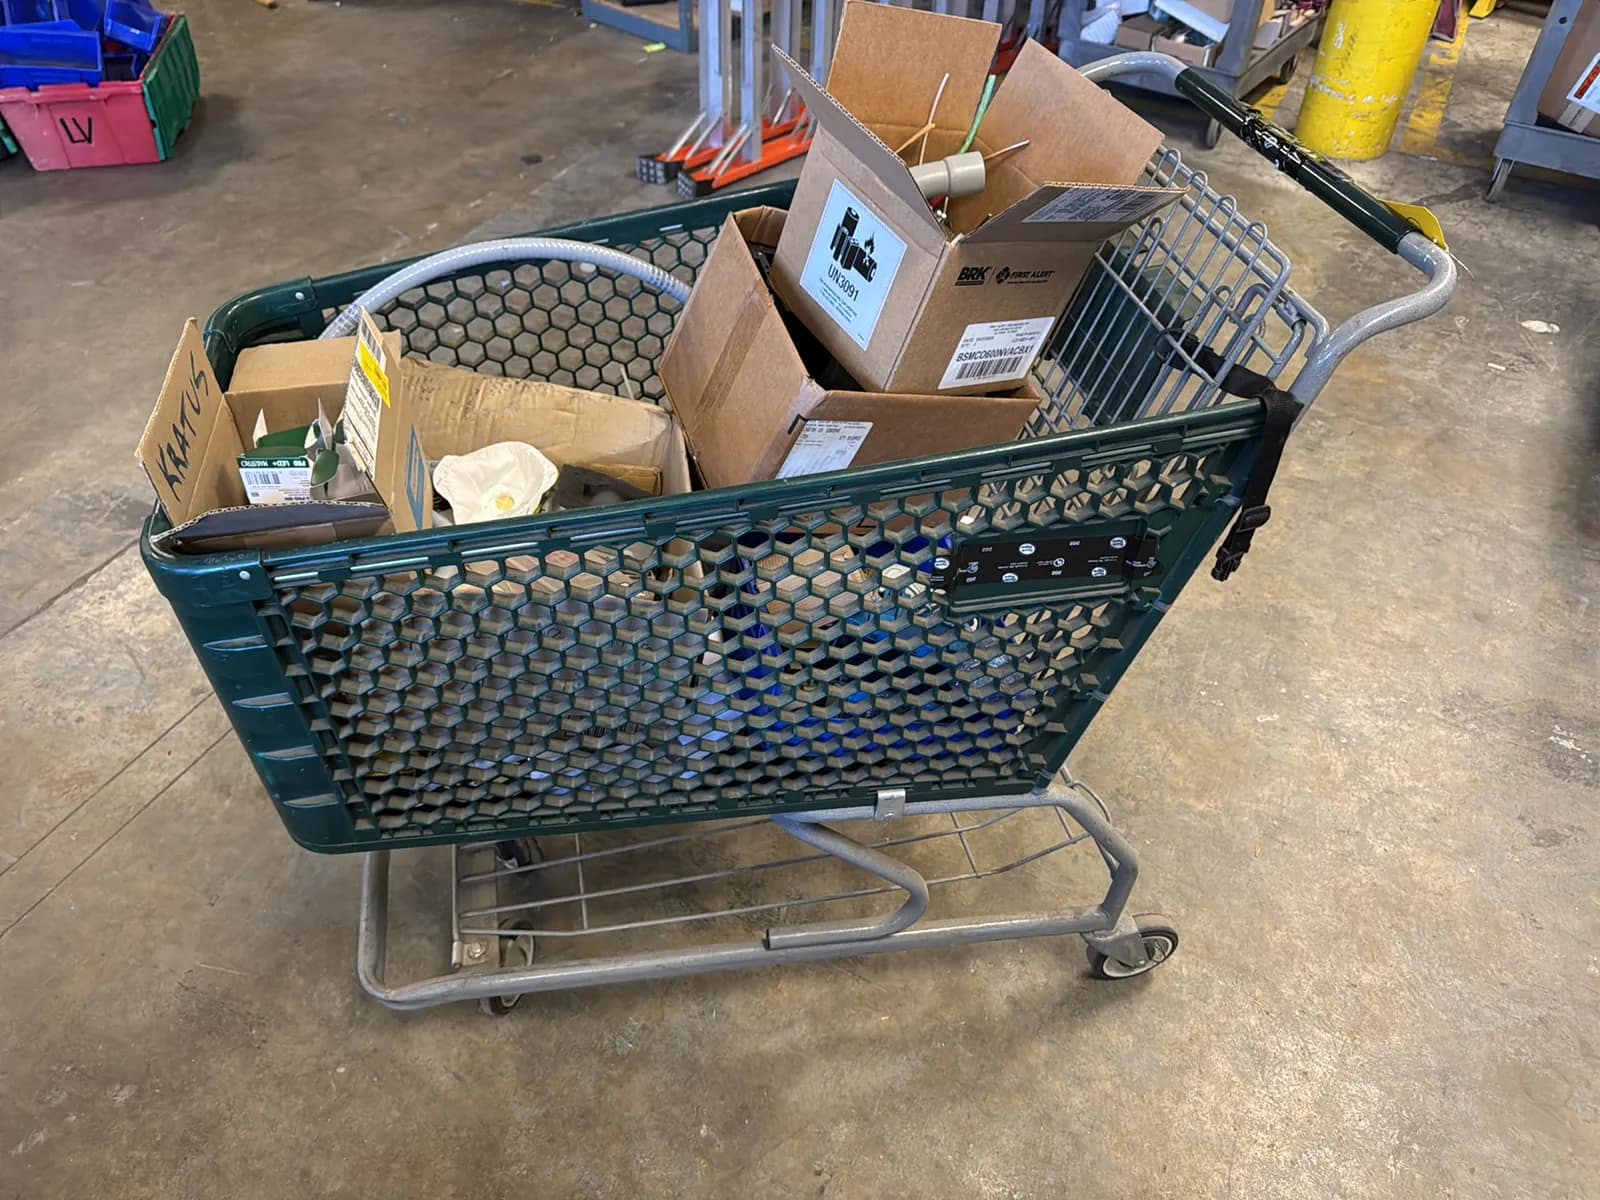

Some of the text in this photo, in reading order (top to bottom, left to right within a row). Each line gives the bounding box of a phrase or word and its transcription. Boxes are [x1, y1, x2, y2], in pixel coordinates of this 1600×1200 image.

[59, 117, 93, 144] LV
[827, 263, 859, 302] UN3091
[957, 266, 992, 281] BRK
[1010, 270, 1056, 279] FIRST ALERT
[155, 349, 209, 503] KRATUS
